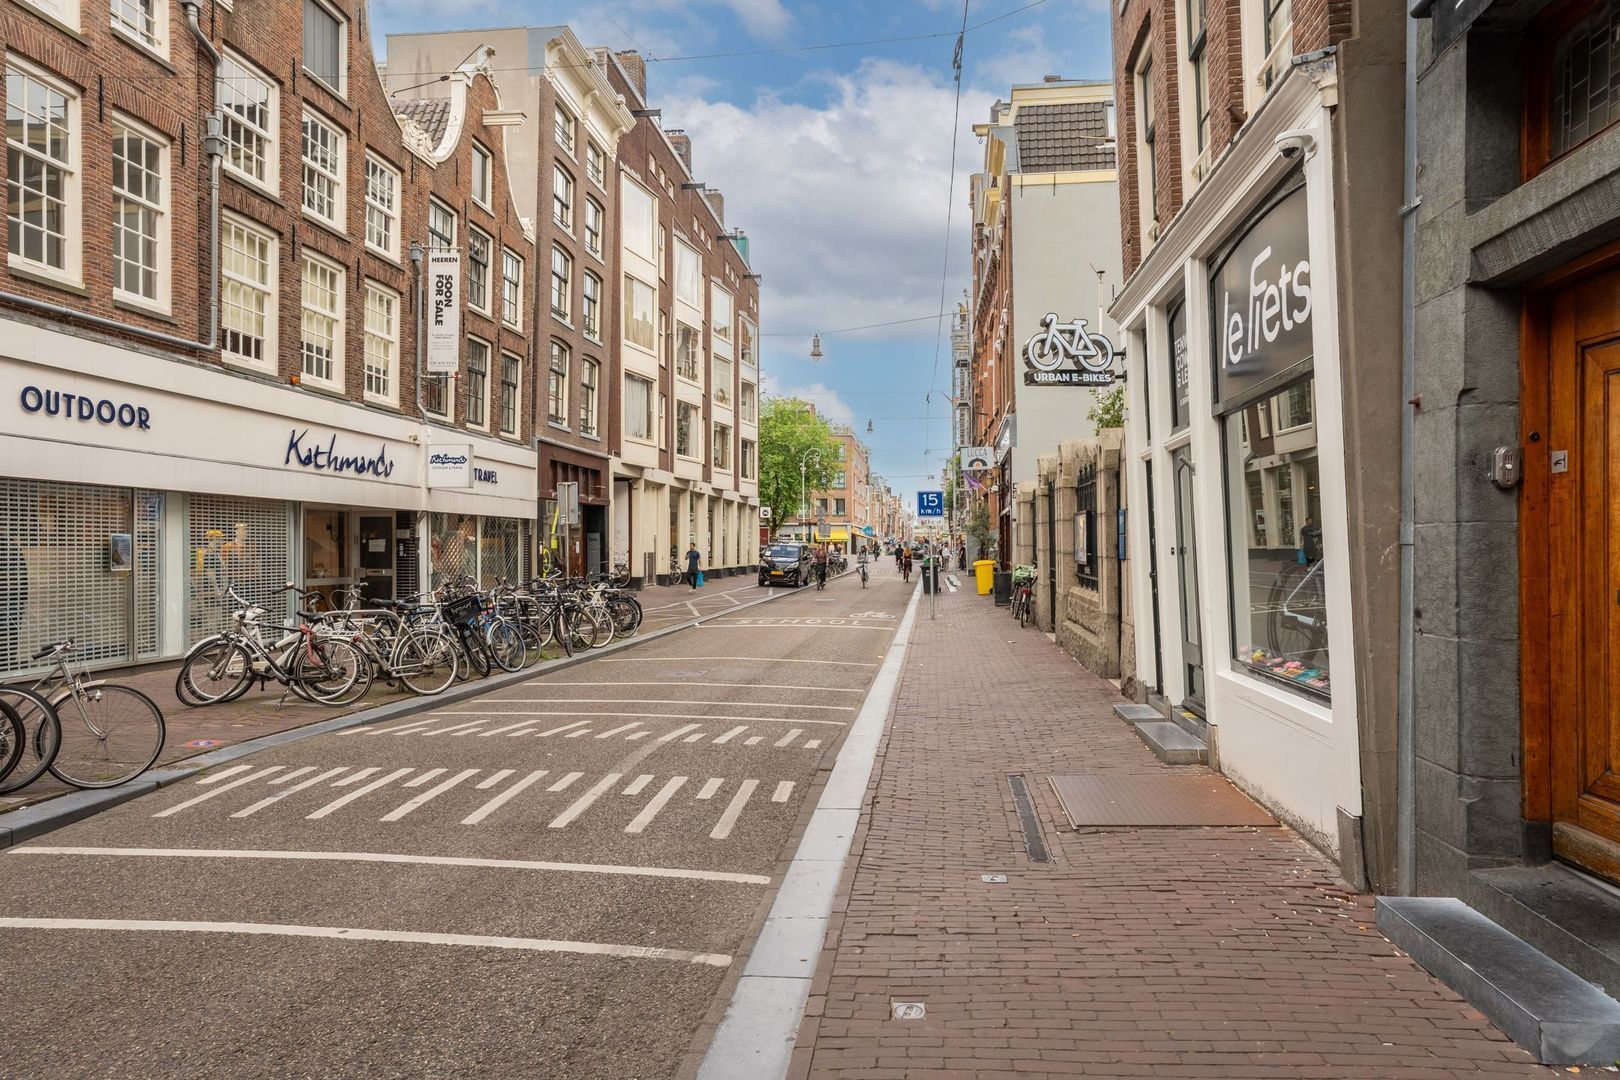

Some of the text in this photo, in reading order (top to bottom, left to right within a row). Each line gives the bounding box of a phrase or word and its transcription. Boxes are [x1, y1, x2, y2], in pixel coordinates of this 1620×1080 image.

[434, 274, 444, 326] FOR SALE
[444, 274, 453, 308] SOON
[1034, 372, 1111, 382] URBAN E-BIKES
[20, 385, 151, 429] OUTDOOR
[284, 428, 394, 478] Kathmandu
[967, 447, 988, 457] LUCCA
[474, 468, 498, 485] TRAVEL
[922, 493, 939, 506] 15
